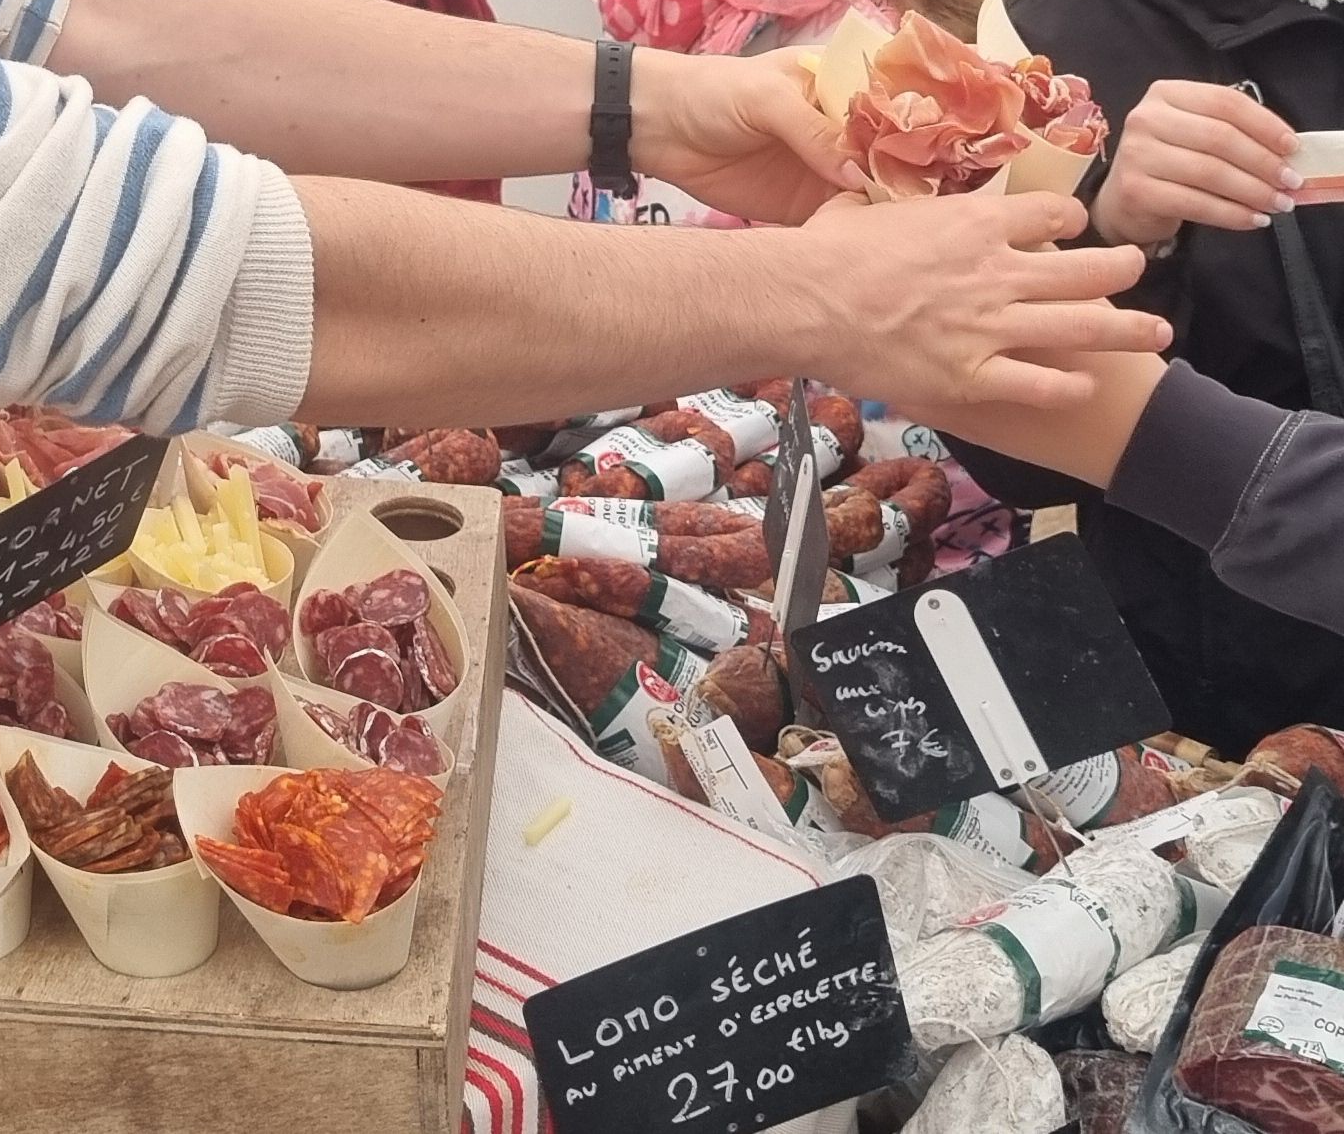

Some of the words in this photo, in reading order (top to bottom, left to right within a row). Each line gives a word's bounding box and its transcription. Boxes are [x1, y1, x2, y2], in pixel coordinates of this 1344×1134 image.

[51, 545, 92, 577] 12
[917, 729, 949, 758] €
[558, 994, 679, 1065] LOMO
[710, 927, 818, 1002] SÉCHÉ
[566, 1082, 597, 1105] AU
[718, 961, 878, 1038] D'ESPELETTE
[667, 1060, 796, 1124] 27,00
